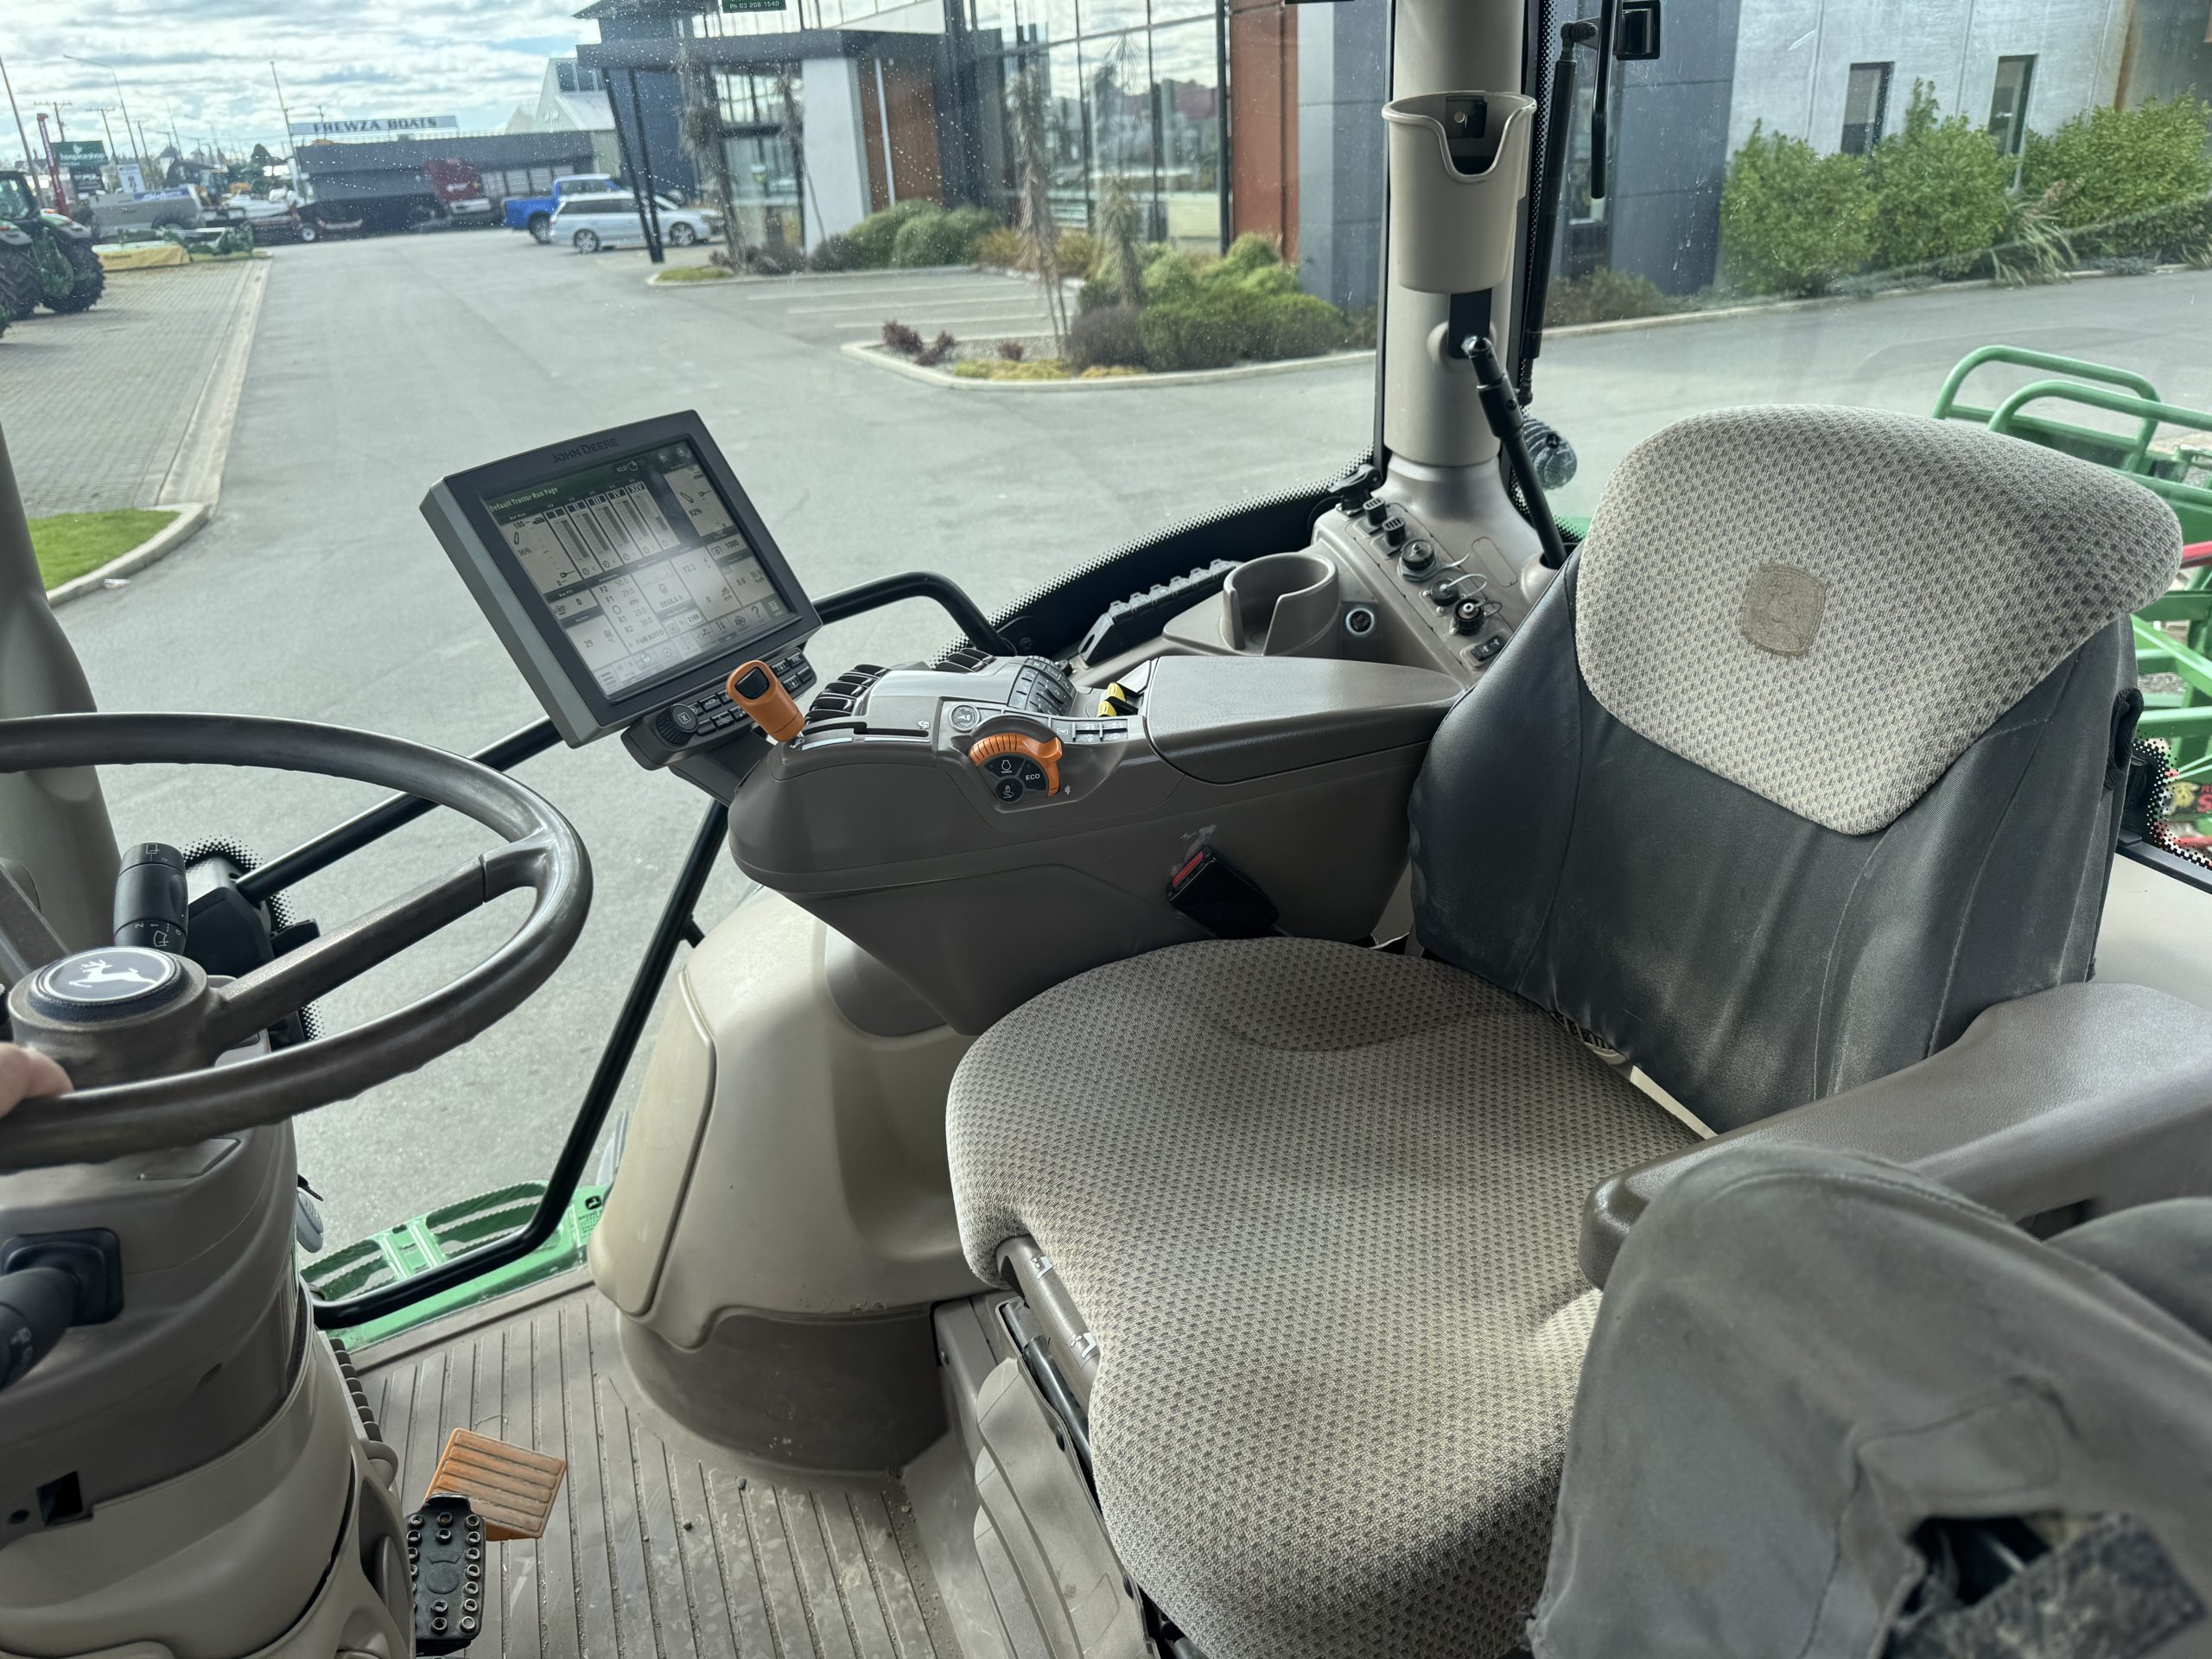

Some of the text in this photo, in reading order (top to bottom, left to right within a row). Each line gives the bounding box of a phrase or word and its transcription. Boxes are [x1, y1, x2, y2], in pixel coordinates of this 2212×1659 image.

[387, 118, 436, 130] BOATS
[553, 438, 619, 463] JOHN DEERE
[489, 486, 558, 512] Default Tractor Run Page
[689, 508, 702, 518] 92%
[513, 520, 525, 530] 100
[725, 539, 739, 550] 1000
[518, 548, 531, 557] 96%
[647, 629, 664, 642] AUTO
[584, 639, 594, 648] 29
[1026, 772, 1040, 781] ECO
